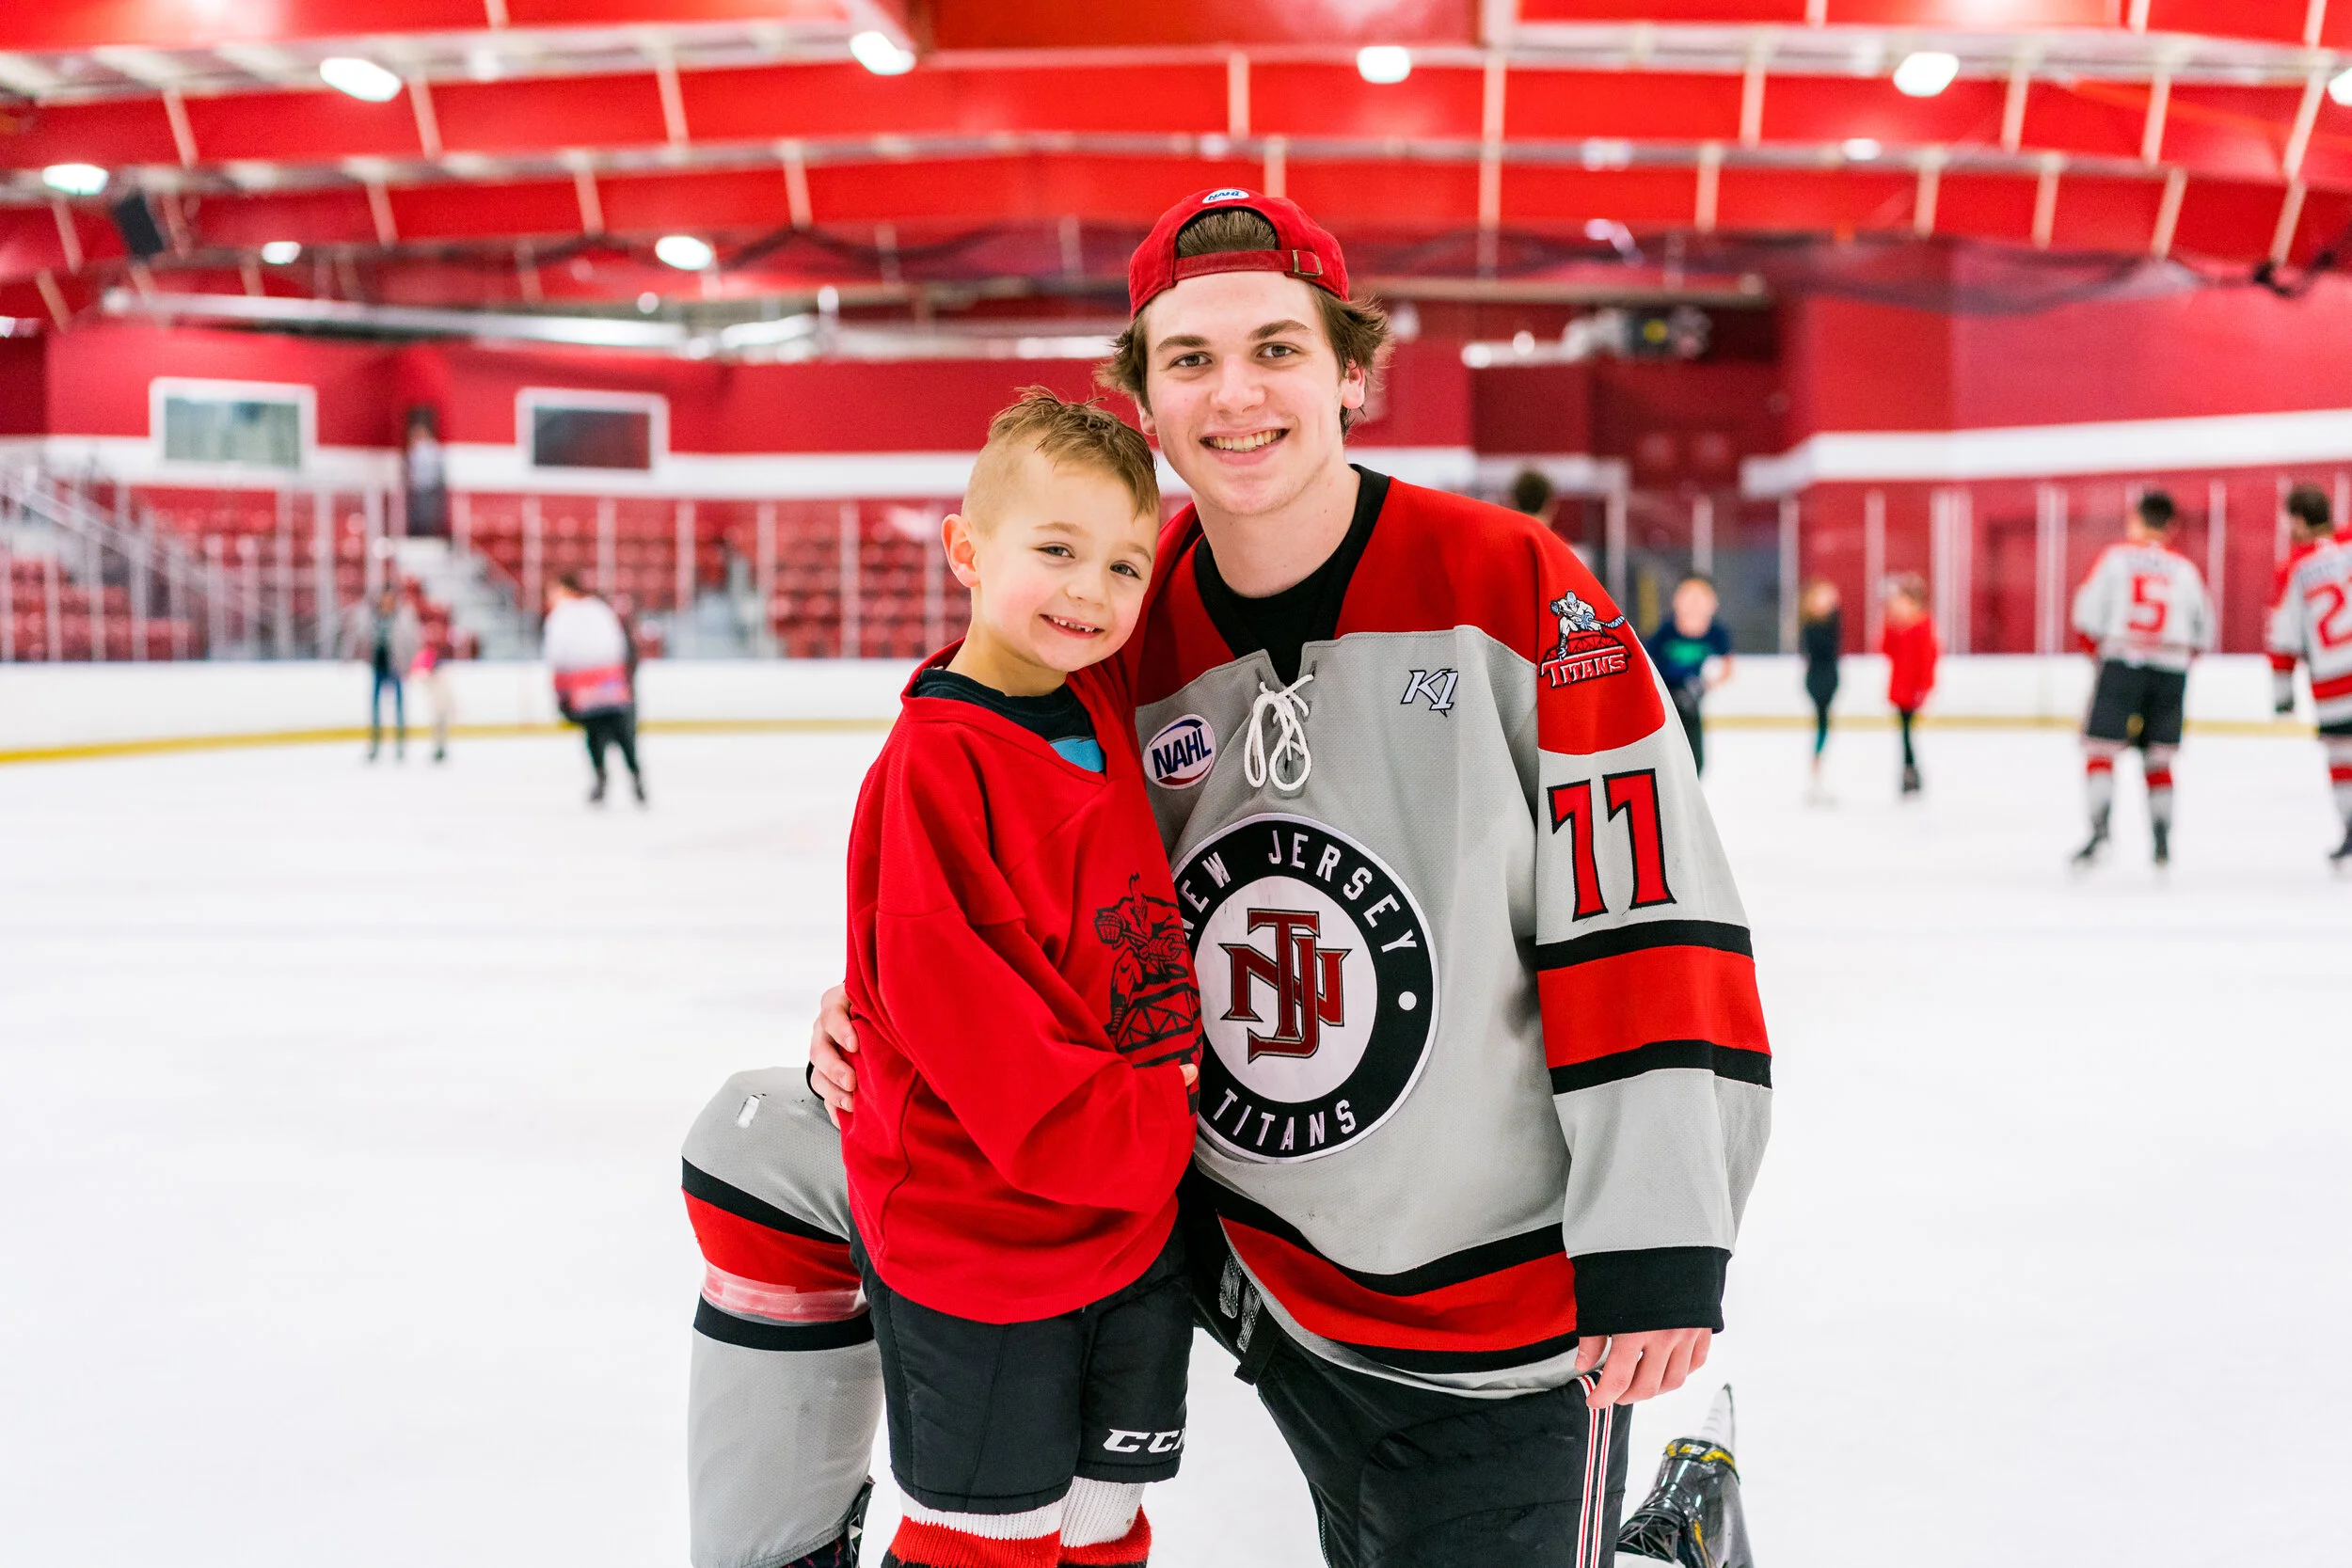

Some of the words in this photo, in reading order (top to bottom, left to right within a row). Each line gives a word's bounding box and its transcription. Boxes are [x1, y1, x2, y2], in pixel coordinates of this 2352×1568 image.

[2128, 571, 2168, 633] 5
[1540, 646, 1628, 688] TITANS
[1152, 727, 1213, 779] NAHL
[1546, 768, 1677, 922] 11
[1268, 830, 1418, 954] JERSEY
[1213, 1087, 1357, 1151] TITANS
